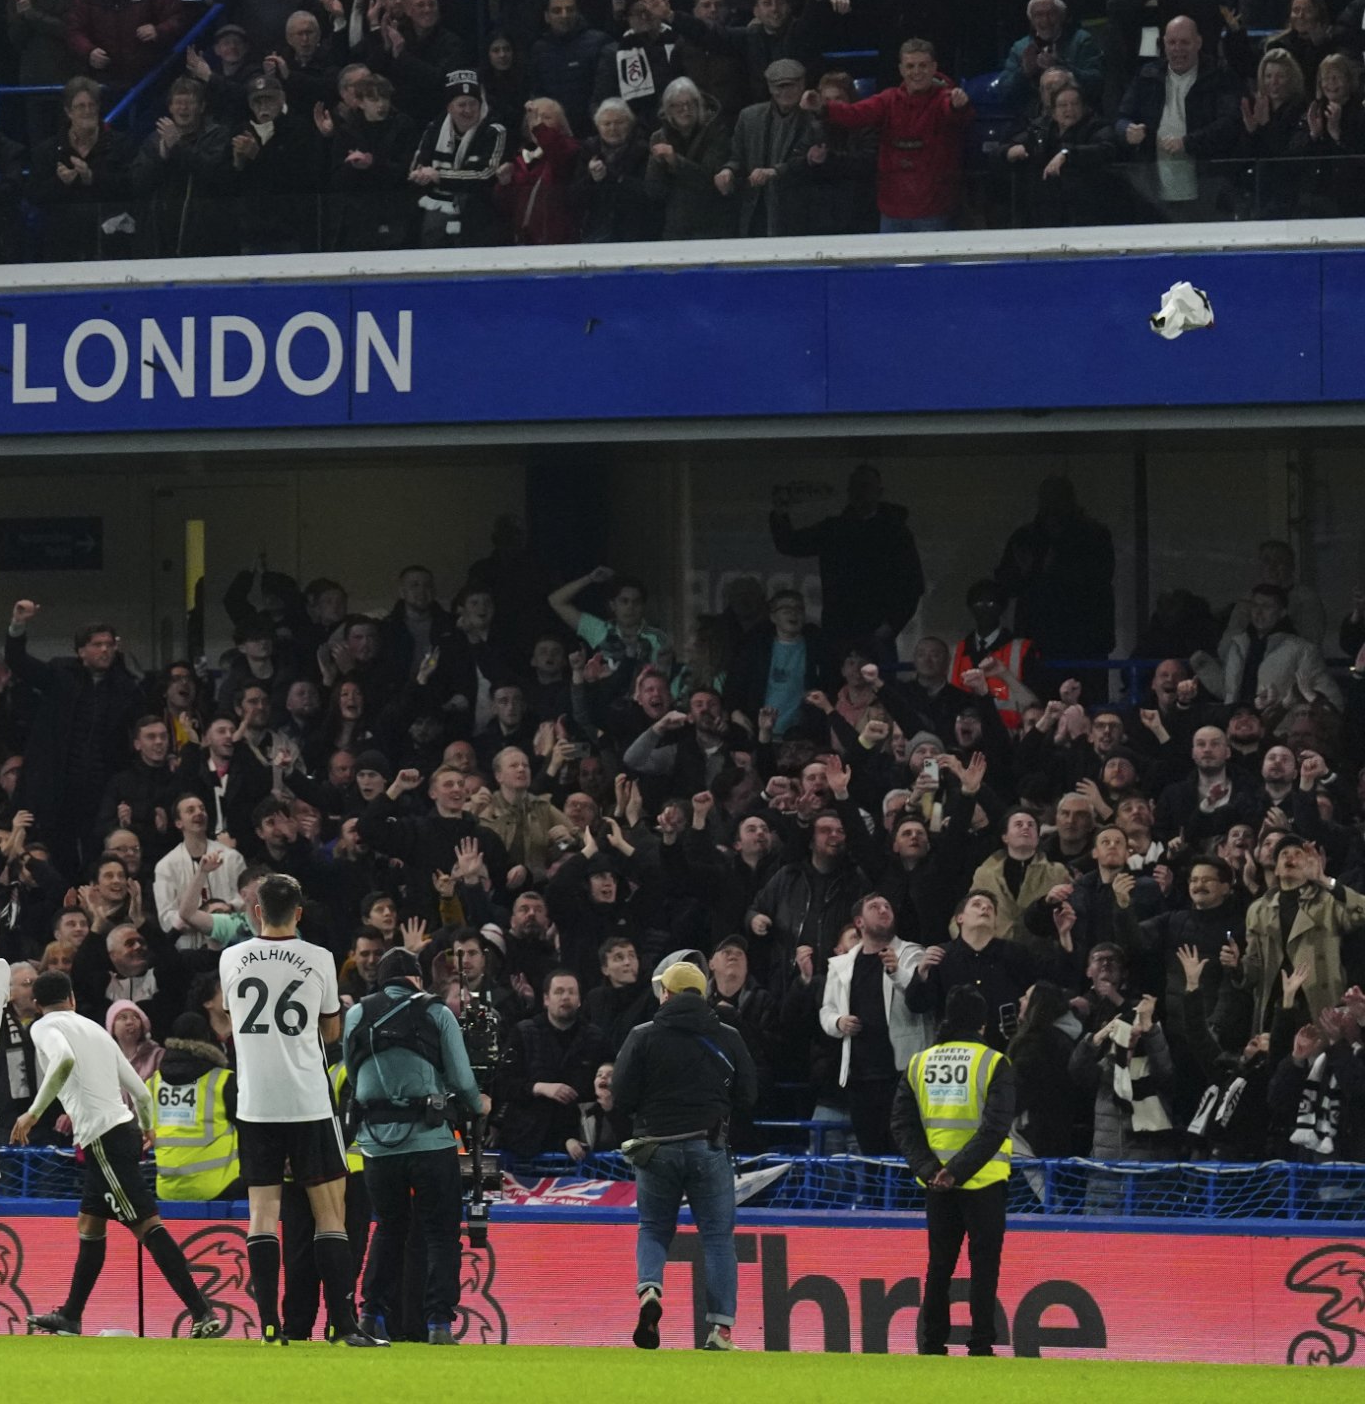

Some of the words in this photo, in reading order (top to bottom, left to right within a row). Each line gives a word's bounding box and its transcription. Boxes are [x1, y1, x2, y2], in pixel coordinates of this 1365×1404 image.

[12, 309, 413, 404] LONDON
[236, 976, 309, 1037] 26
[927, 1054, 971, 1062] STEWARD
[924, 1064, 968, 1085] 530
[157, 1086, 196, 1107] 654
[103, 1191, 121, 1213] 2
